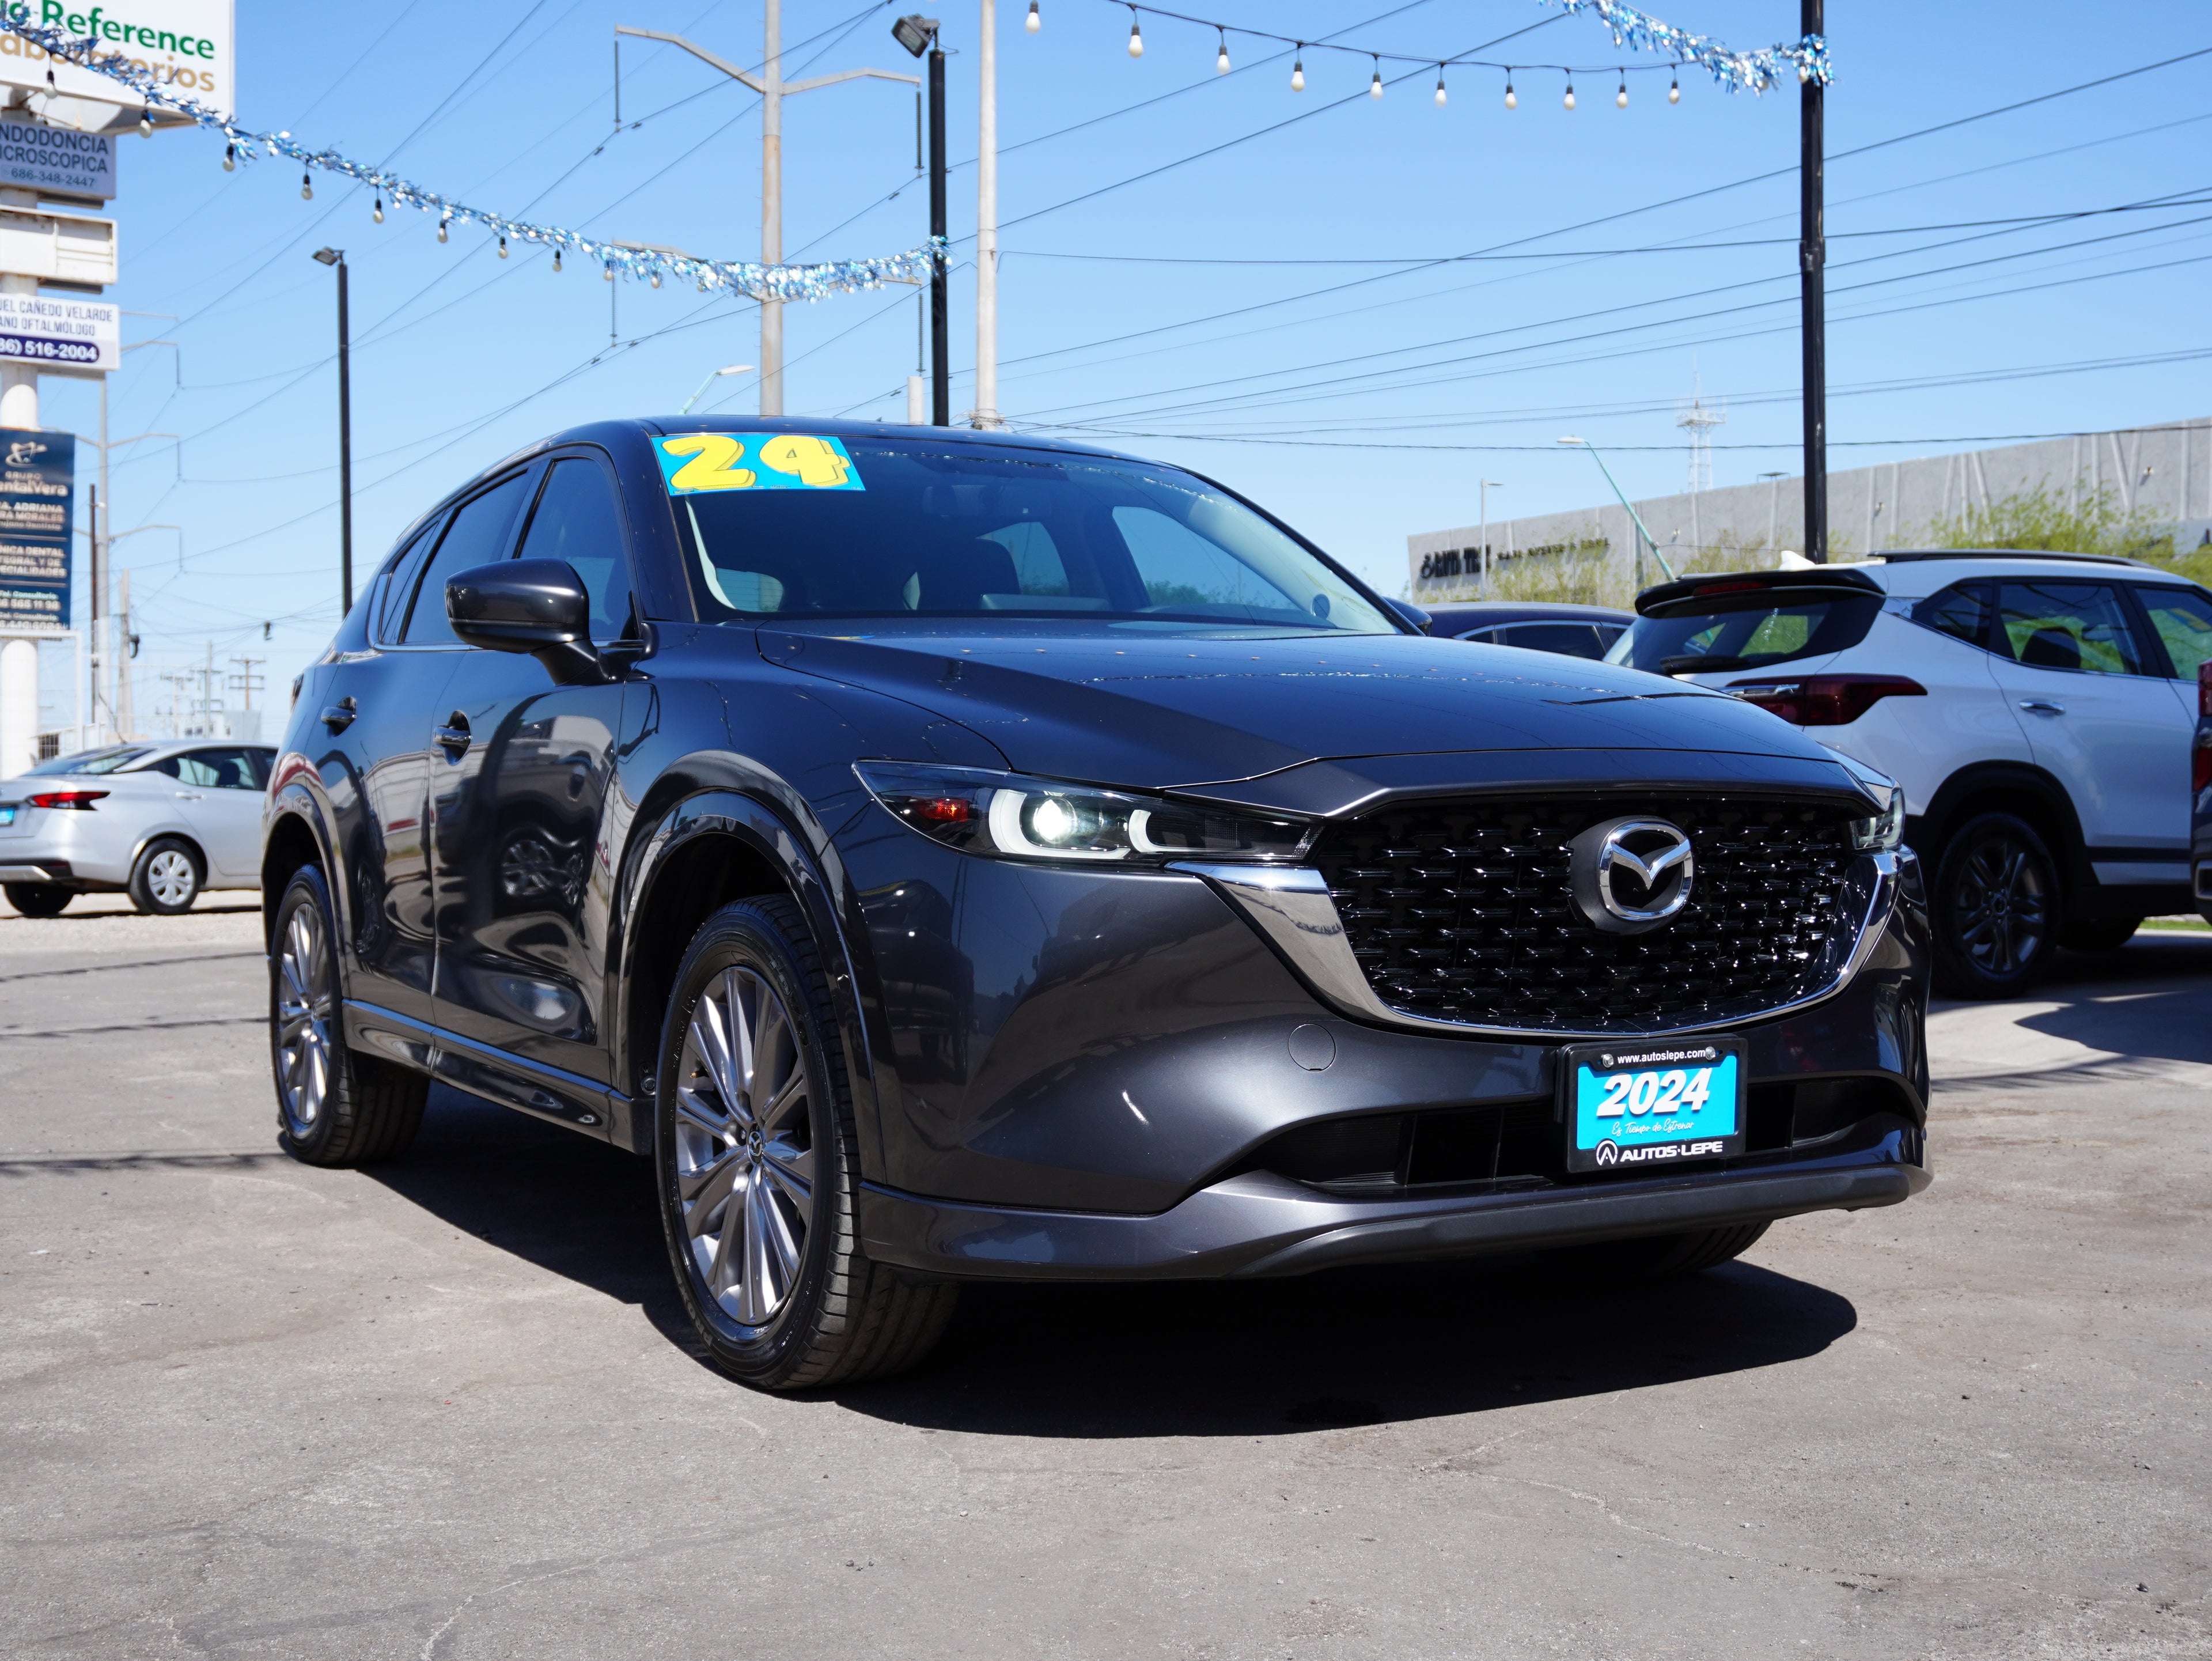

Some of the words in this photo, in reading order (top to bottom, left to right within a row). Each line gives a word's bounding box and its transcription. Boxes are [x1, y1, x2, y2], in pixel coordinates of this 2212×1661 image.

[11, 168, 95, 187] 686-348-2447
[20, 300, 62, 316] CAÑEDO
[66, 305, 113, 322] VELARDE
[21, 318, 95, 336] OFTALMÓLOGO
[25, 340, 98, 361] 516-2004
[14, 502, 65, 514] ADRIANA
[16, 512, 65, 523] MORALES
[25, 546, 66, 558] DENTAL
[1618, 1049, 1706, 1064] www.autoslepe.com
[1596, 1068, 1712, 1116] 2024
[1612, 1121, 1622, 1136] Es
[1625, 1121, 1651, 1134] Tiempo
[1652, 1122, 1662, 1132] de
[1663, 1118, 1694, 1134] Estrenar
